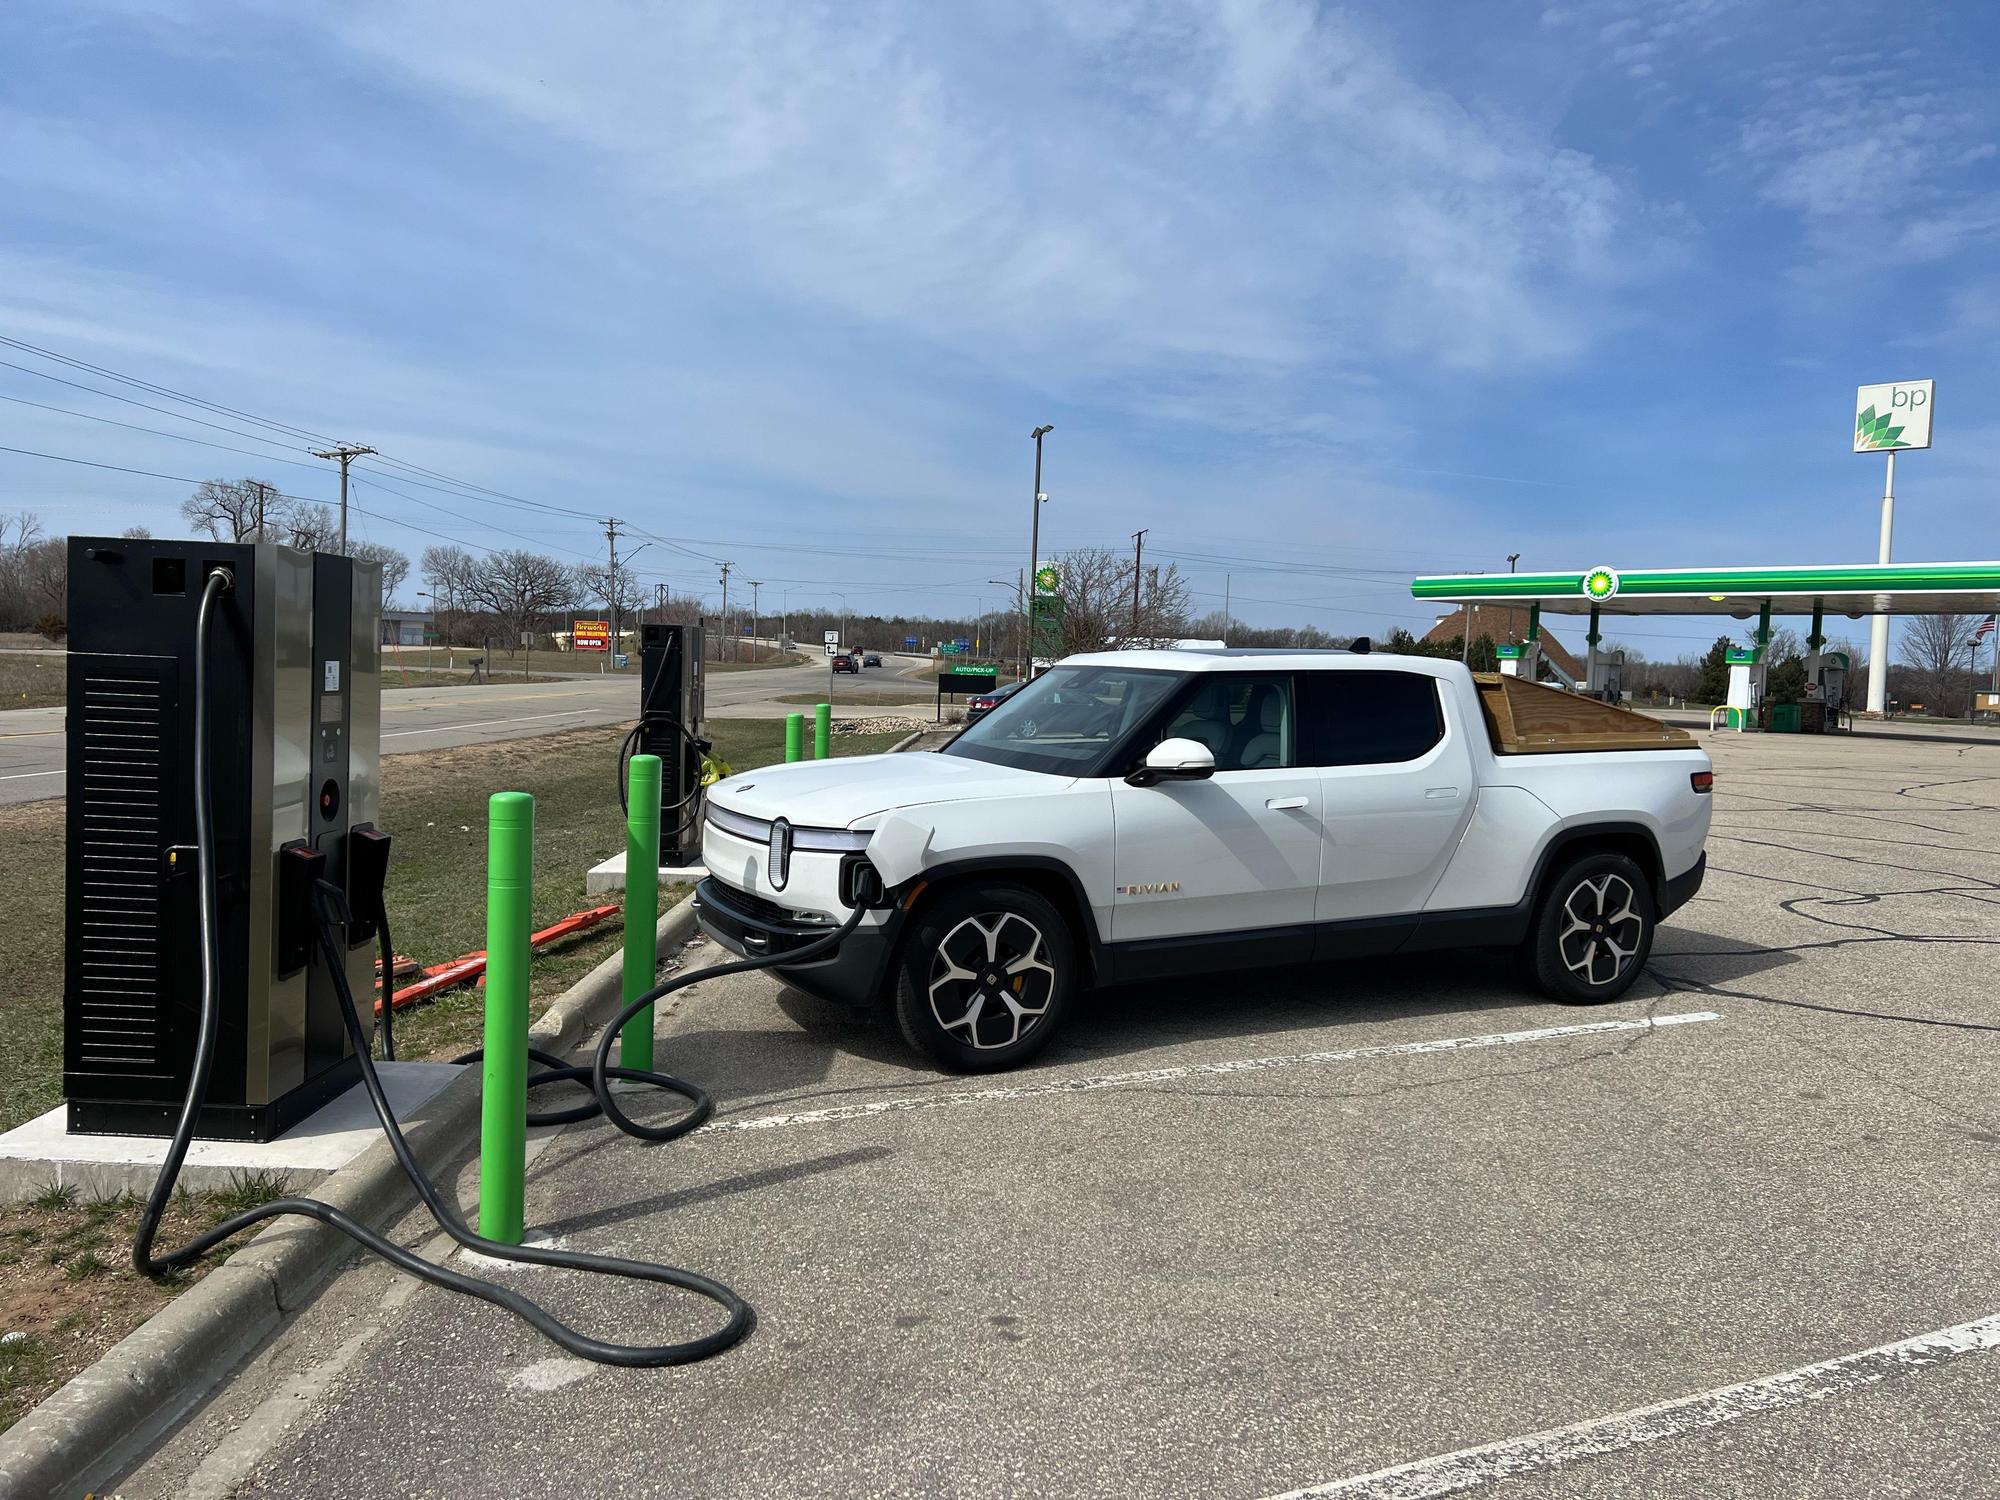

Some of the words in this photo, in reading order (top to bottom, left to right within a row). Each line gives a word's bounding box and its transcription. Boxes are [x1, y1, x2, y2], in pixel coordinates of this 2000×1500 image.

[1892, 386, 1927, 412] bp
[576, 623, 607, 631] Fireworks
[829, 634, 834, 642] J
[1128, 881, 1180, 896] RIVIAN
